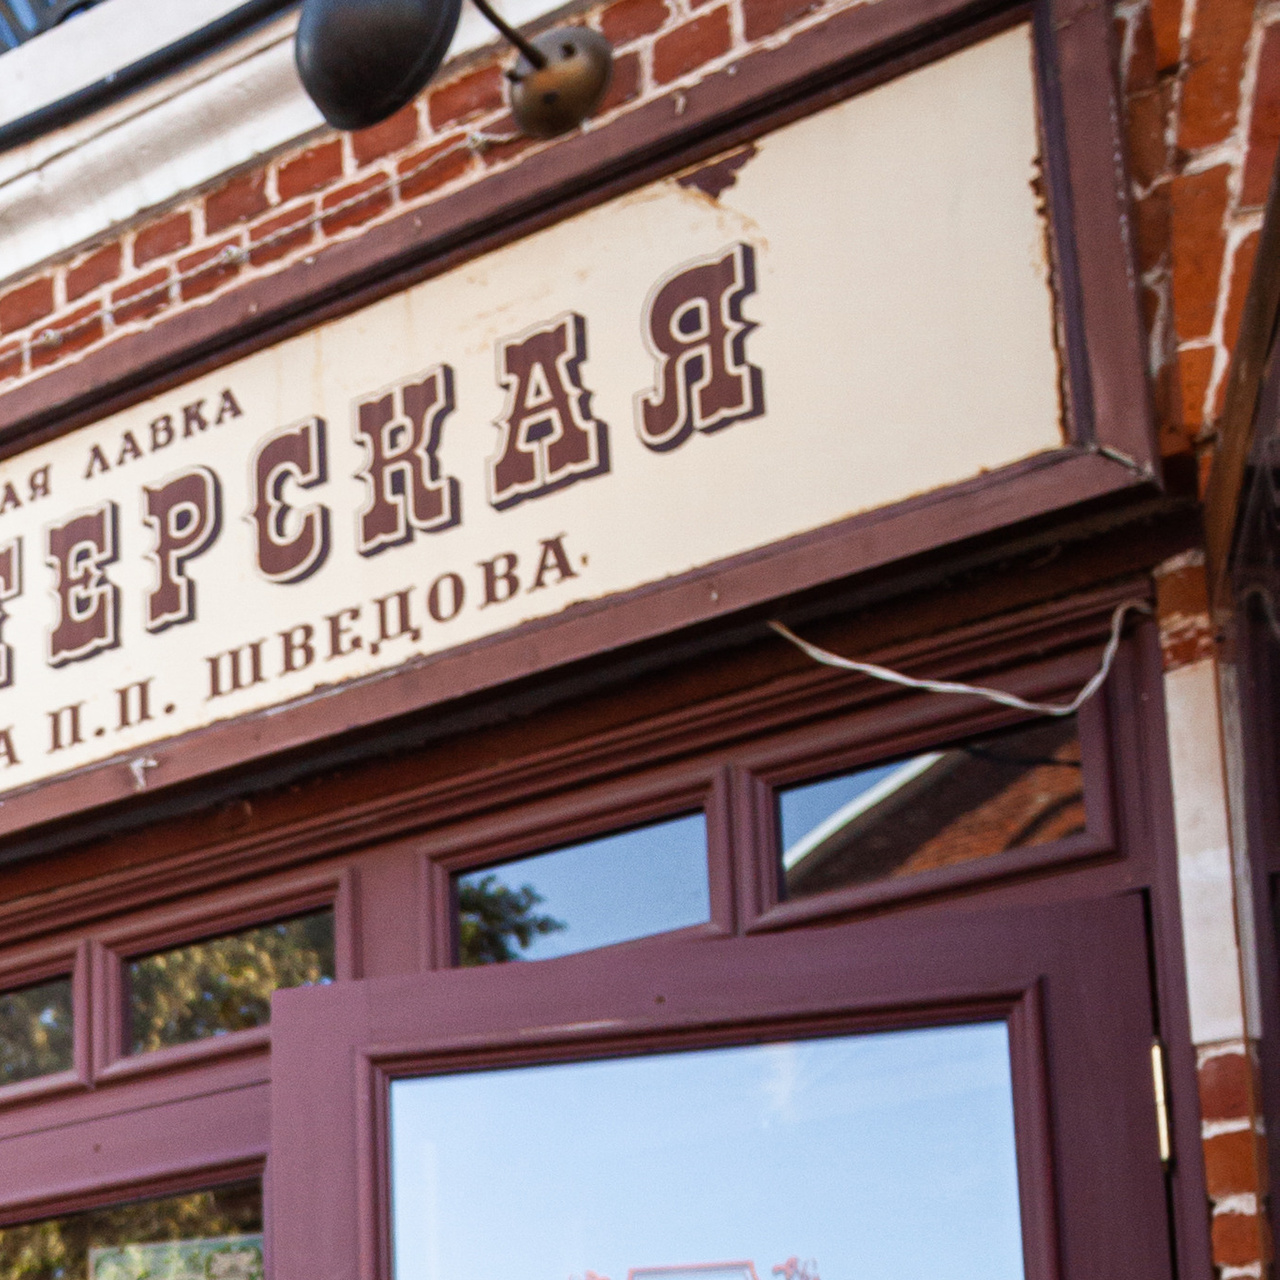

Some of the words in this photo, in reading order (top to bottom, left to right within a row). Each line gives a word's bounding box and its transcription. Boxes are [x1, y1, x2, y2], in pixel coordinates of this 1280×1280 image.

[84, 387, 244, 479] ЛАВКА
[47, 677, 176, 755] П.П.
[205, 532, 581, 701] ШВЕДОВА
